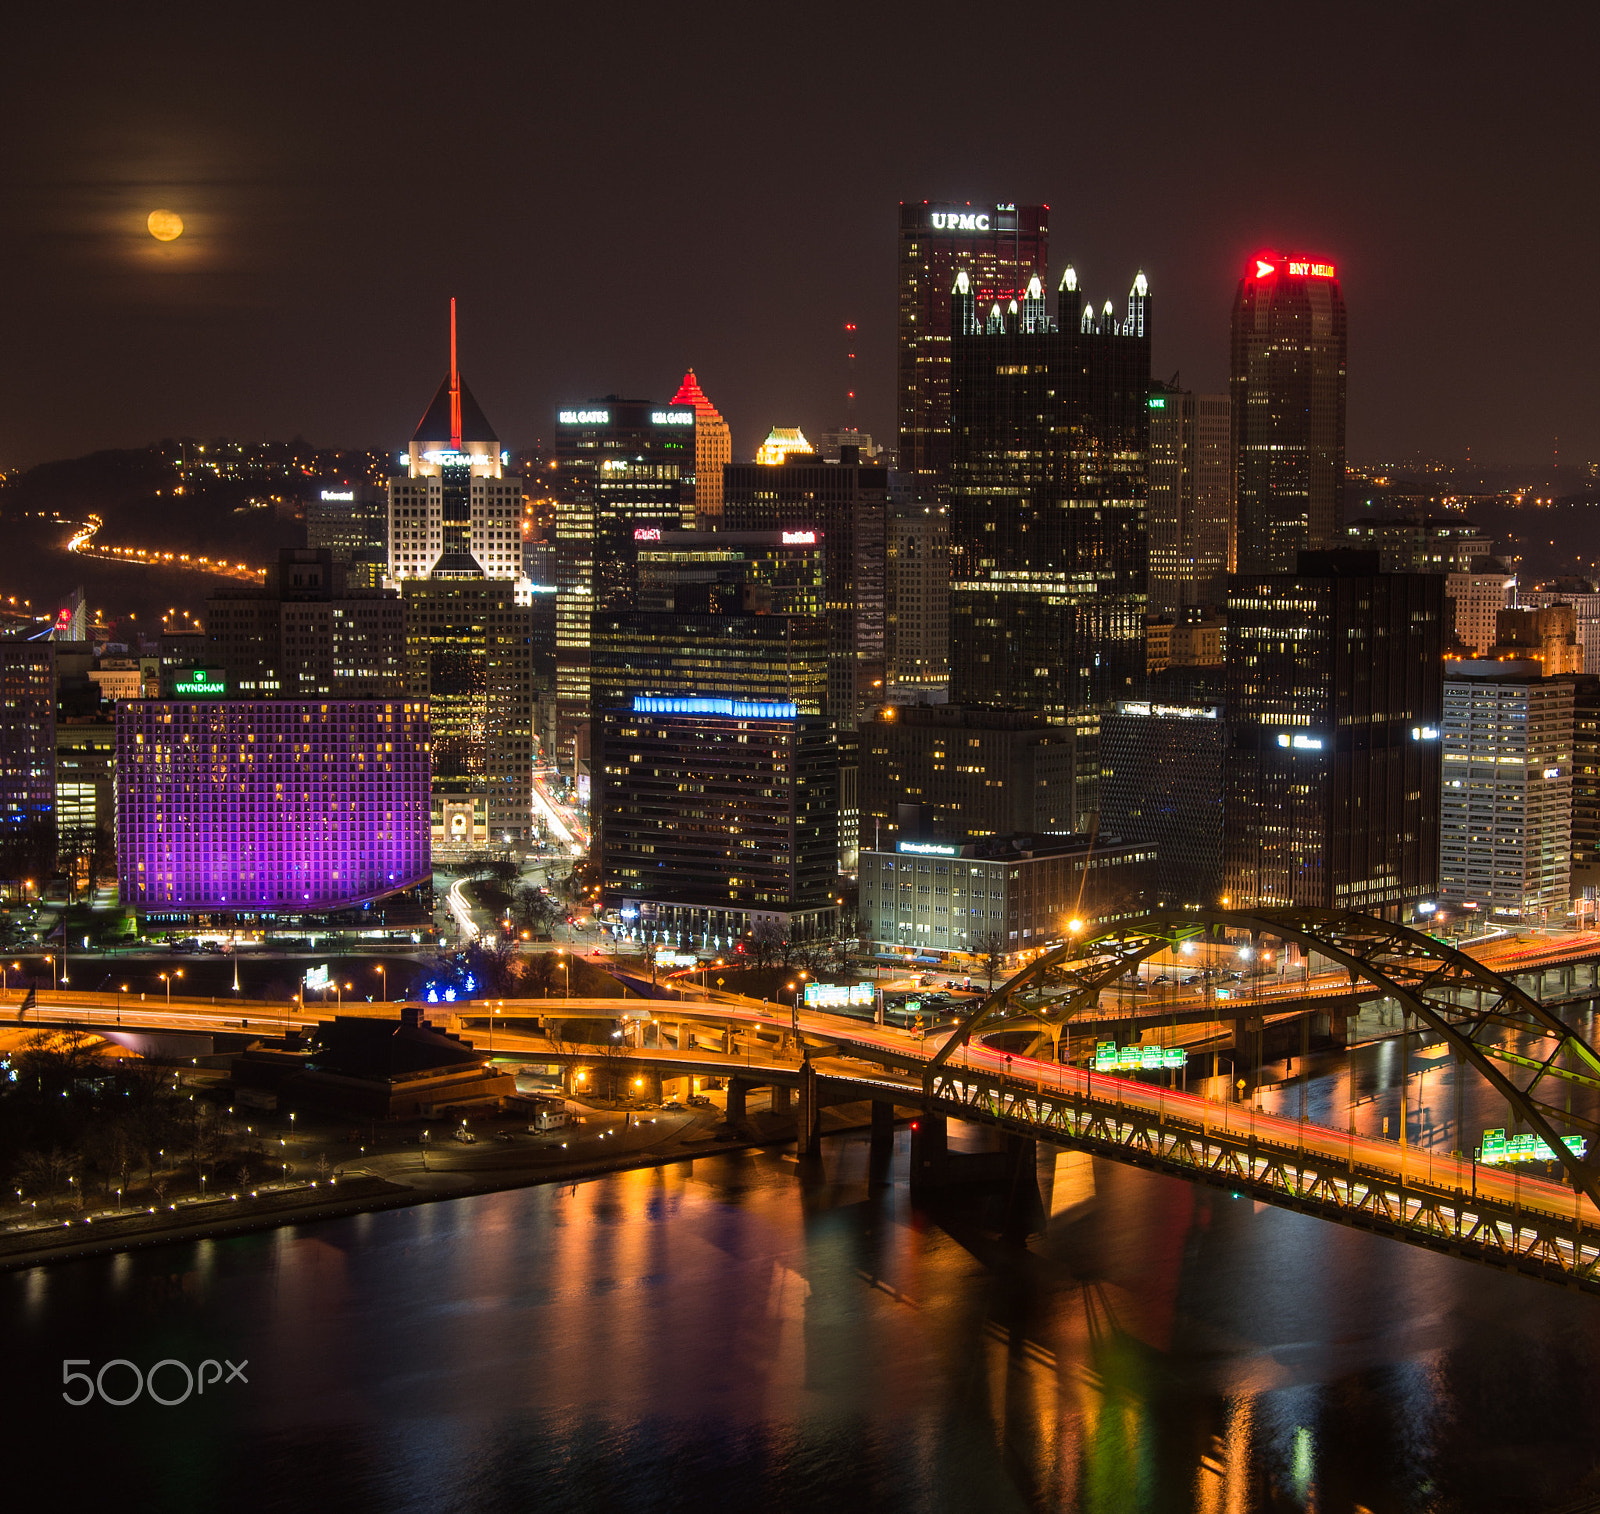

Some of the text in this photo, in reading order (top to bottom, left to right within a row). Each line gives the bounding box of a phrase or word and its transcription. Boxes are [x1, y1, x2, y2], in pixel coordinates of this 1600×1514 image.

[931, 213, 990, 231] UPMC
[1289, 263, 1309, 275] BNY
[578, 411, 609, 423] GATES
[176, 683, 225, 693] WYNDHAM
[1124, 703, 1150, 714] United
